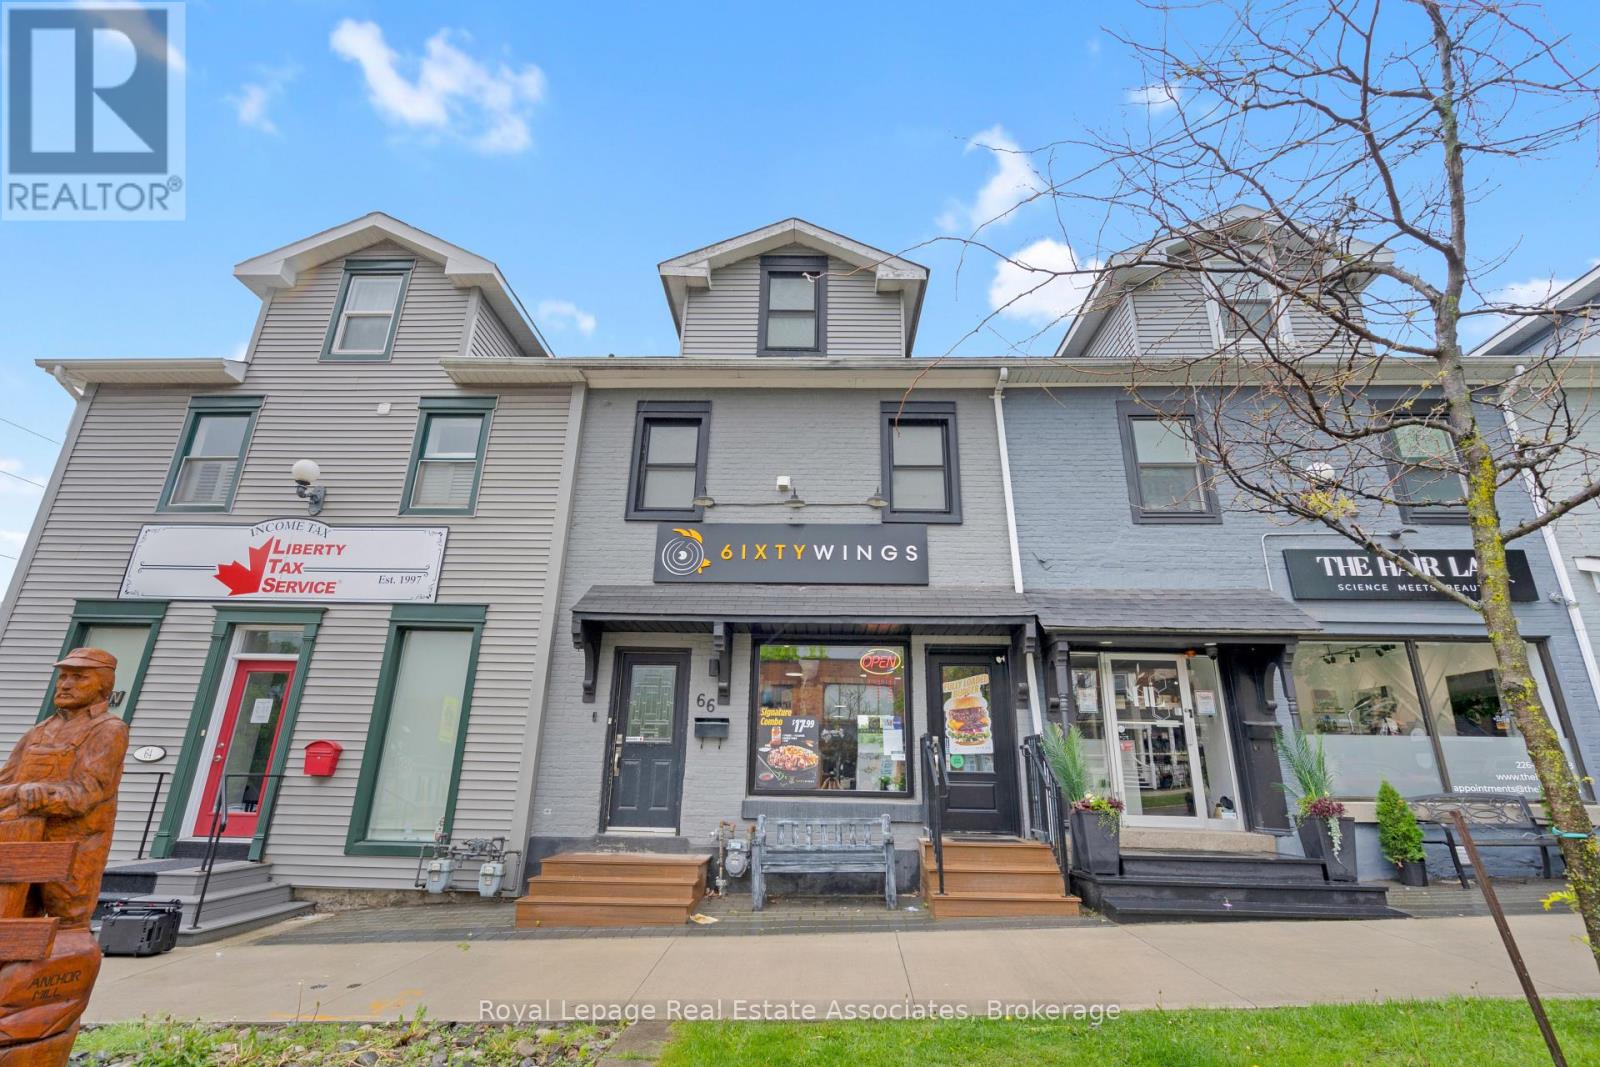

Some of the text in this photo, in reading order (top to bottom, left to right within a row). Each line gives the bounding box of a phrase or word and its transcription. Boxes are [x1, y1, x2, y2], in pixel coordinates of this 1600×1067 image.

[250, 521, 330, 539] INCOME TAX
[272, 539, 346, 556] LIBERTY
[268, 558, 304, 574] TAX
[1316, 556, 1373, 577] THE
[1448, 556, 1478, 577] LA
[261, 577, 336, 594] SERVICE
[378, 574, 422, 585] Est. 1997
[1337, 583, 1389, 592] SCIENCE
[1397, 584, 1437, 592] MEETS
[863, 655, 896, 669] OPEN
[696, 693, 716, 713] 66
[760, 706, 792, 718] Signature
[760, 717, 783, 726] Combo
[27, 970, 81, 991] ANCHOR
